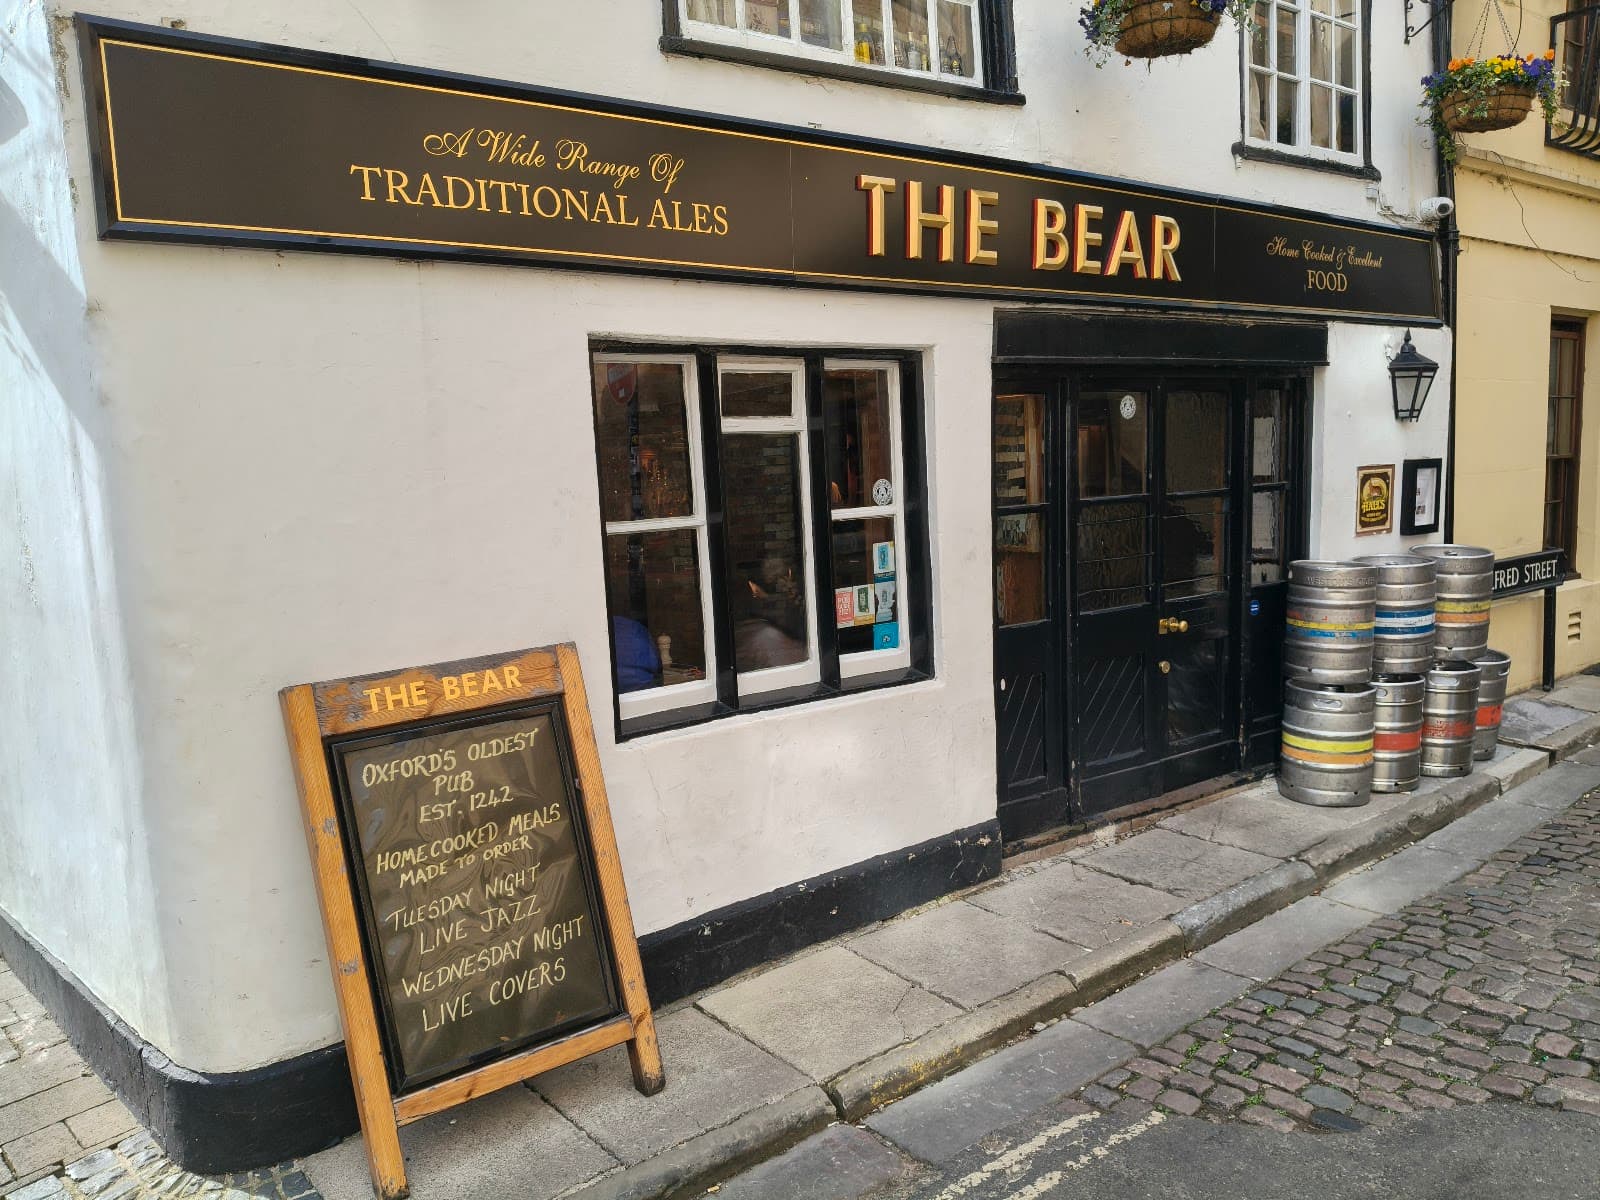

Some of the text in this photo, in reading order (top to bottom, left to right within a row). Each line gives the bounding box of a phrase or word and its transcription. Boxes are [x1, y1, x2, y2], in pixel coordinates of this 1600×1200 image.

[423, 127, 685, 194] A Wide Range Of
[350, 163, 729, 236] TRADITIONAL ALES
[856, 174, 1182, 283] THE BEAR
[1266, 236, 1383, 270] Home Cooked & Excellent
[1306, 269, 1348, 292] FOOD
[1491, 560, 1558, 591] FRED STREET
[362, 665, 522, 713] THE BEAR
[362, 727, 539, 788] OXFORD'S OLDEST
[432, 770, 475, 796] PUB
[470, 785, 514, 812] 1242
[376, 802, 561, 875] HOME COOKED MEALS
[399, 835, 534, 889] MADE TO ORDER
[384, 862, 540, 932] TUESDAY NIGHT
[419, 894, 541, 955] LIVE JAZZ
[402, 915, 585, 998] WEDNESDAY NIGHT
[422, 957, 567, 1032] LIVE COVERS
